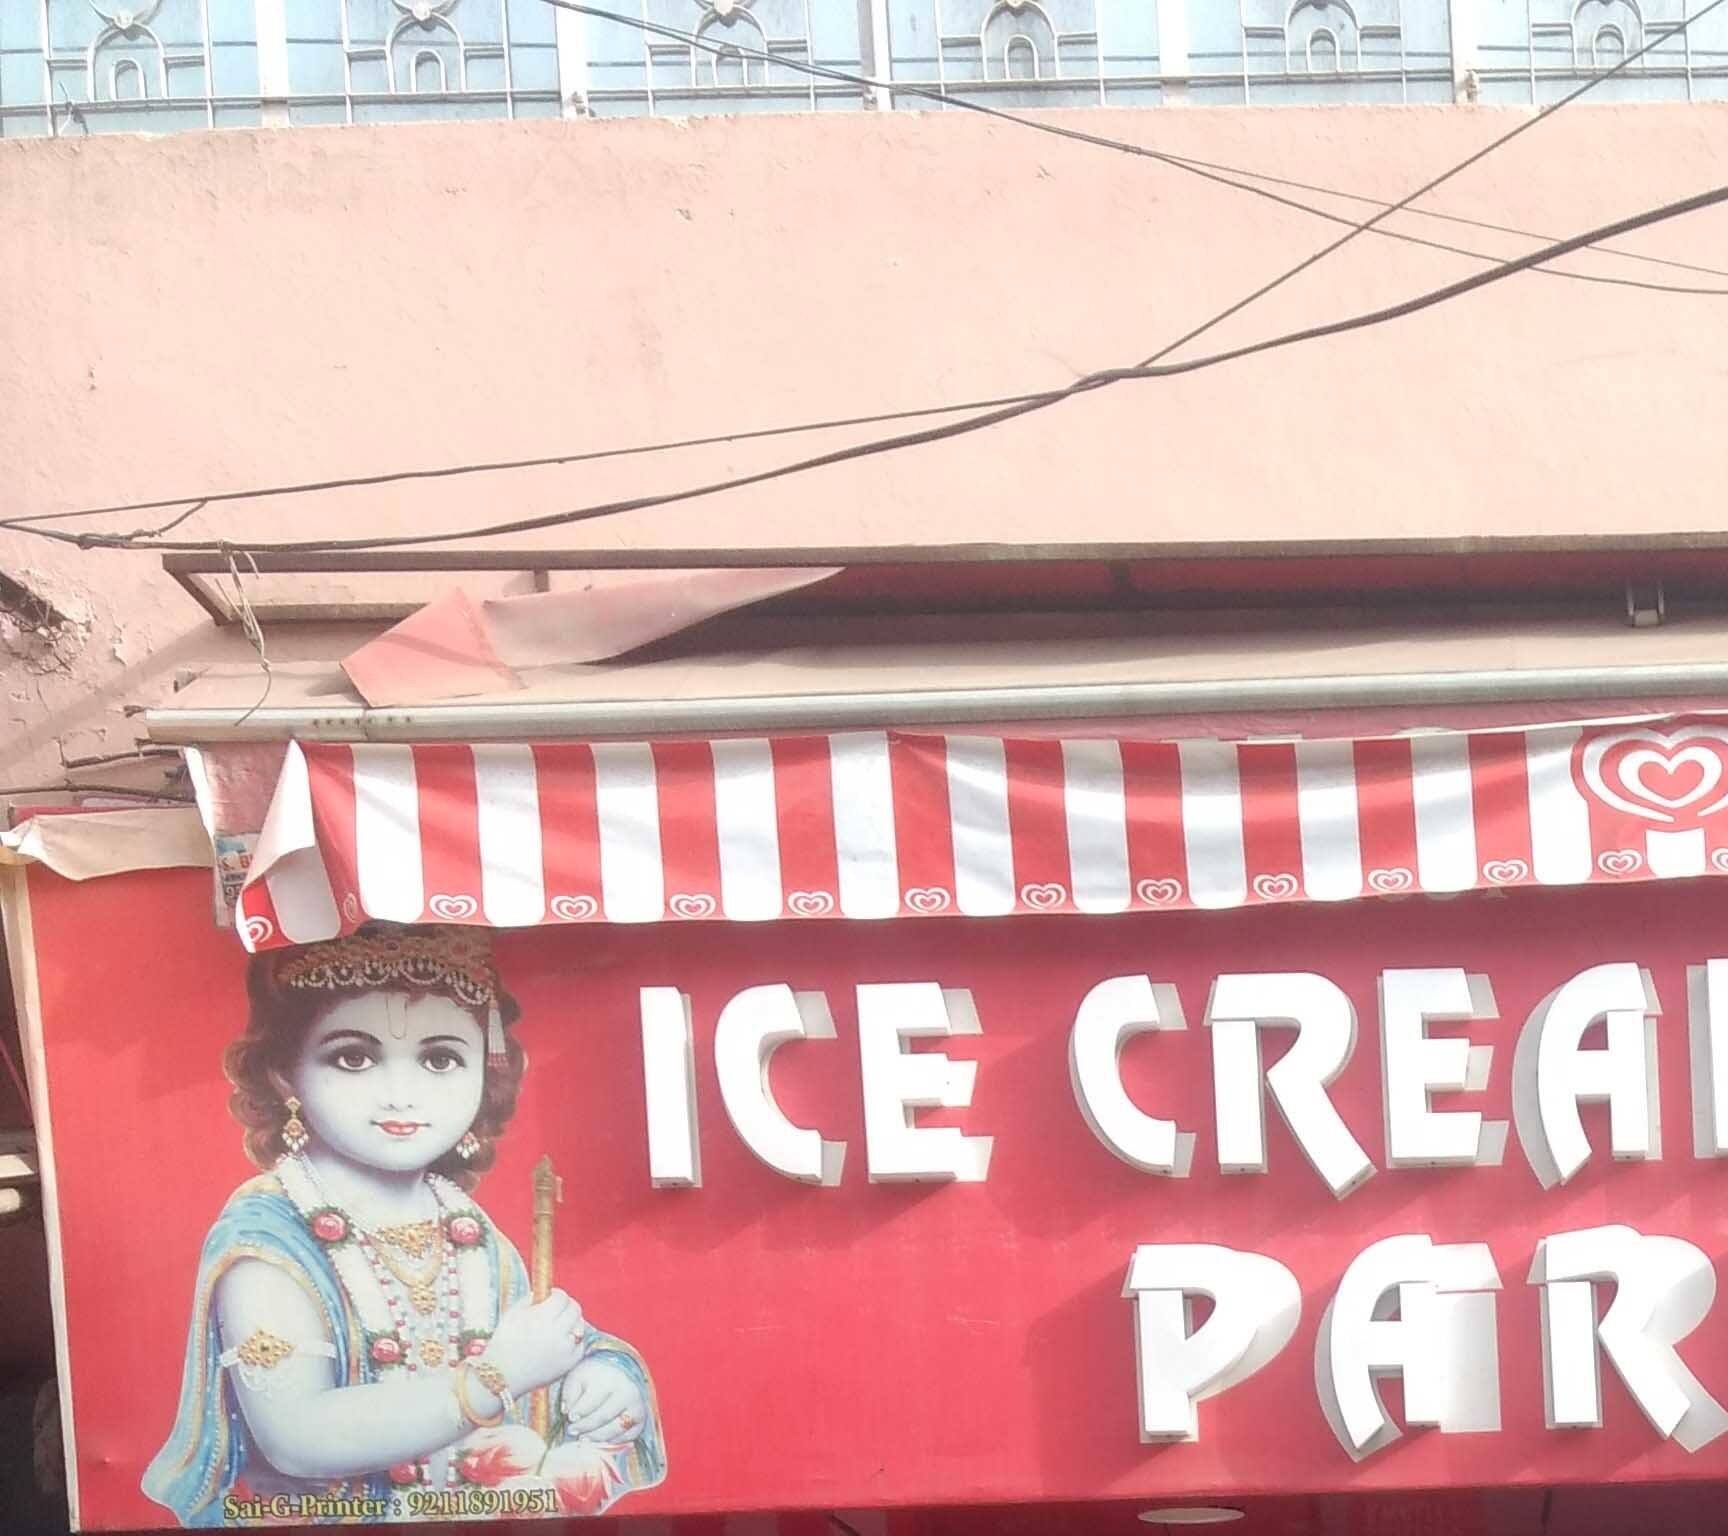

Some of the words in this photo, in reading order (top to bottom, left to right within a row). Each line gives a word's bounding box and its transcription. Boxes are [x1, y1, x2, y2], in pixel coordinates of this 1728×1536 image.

[641, 982, 993, 1188] ICE
[223, 1494, 386, 1520] Sai-G-Printer
[408, 1487, 559, 1516] 9211891951
